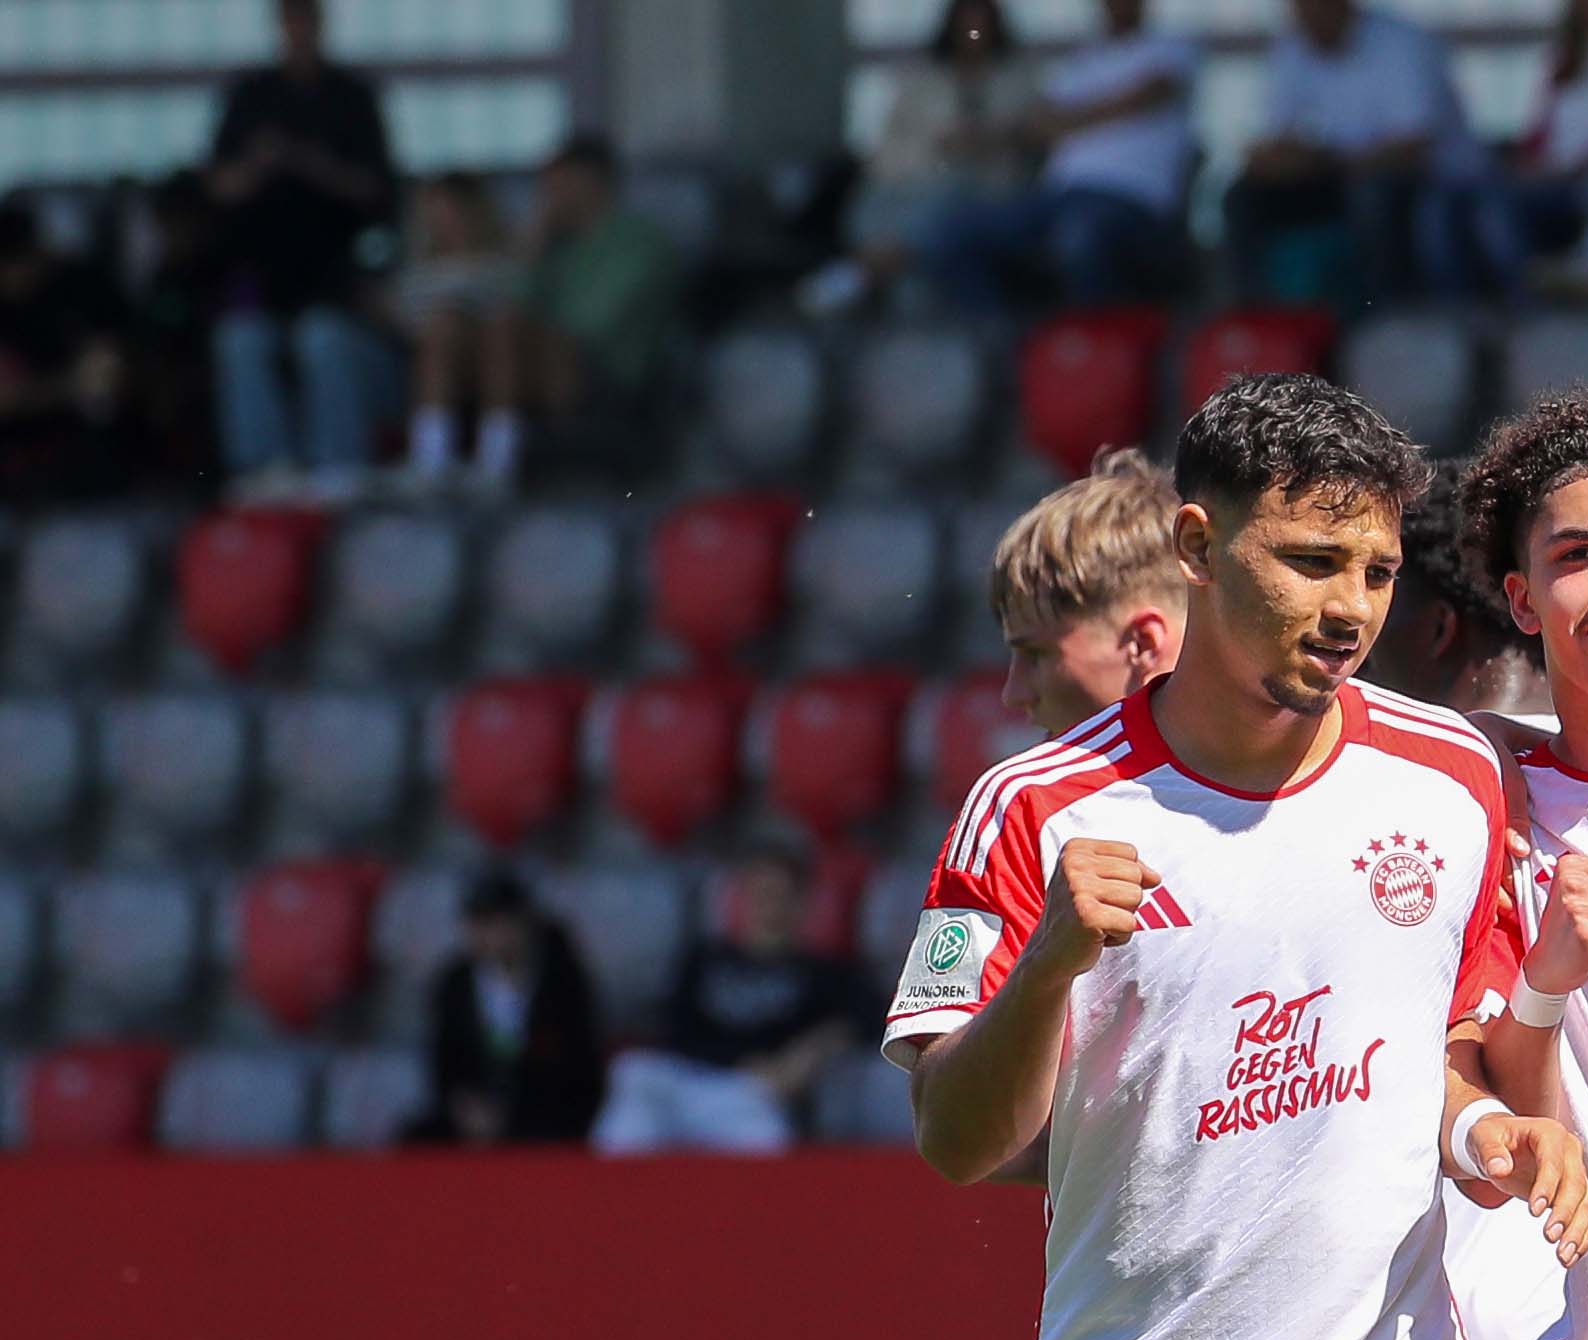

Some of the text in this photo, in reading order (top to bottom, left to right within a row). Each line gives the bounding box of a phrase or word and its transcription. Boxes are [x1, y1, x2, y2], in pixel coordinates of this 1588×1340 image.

[1386, 857, 1432, 884] BAYERN
[1226, 1016, 1322, 1091] GEGEN
[1231, 984, 1334, 1054] ROT
[1195, 1037, 1386, 1143] RASSISMUS
